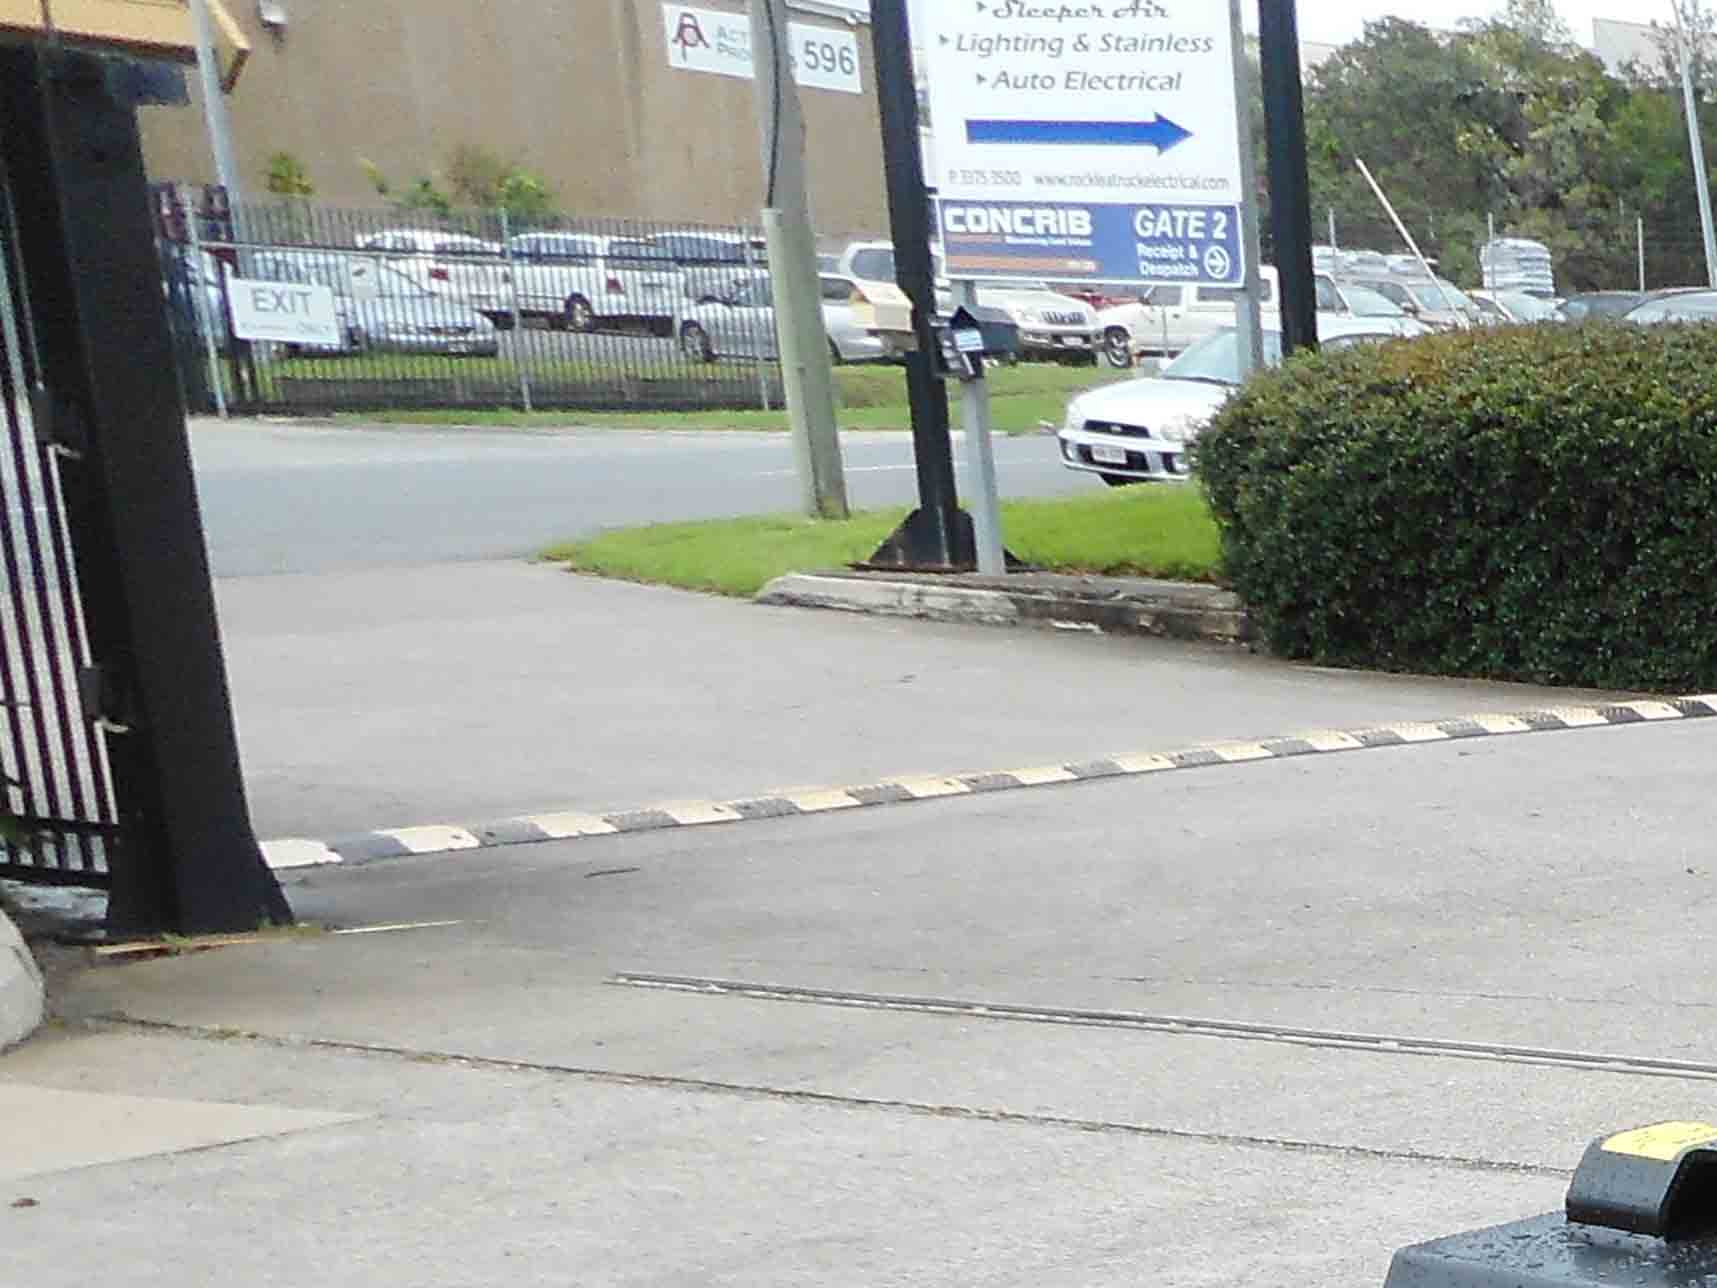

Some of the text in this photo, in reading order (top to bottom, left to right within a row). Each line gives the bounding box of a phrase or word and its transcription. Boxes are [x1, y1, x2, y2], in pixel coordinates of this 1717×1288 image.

[803, 39, 856, 75] 596
[956, 33, 1214, 58] Lighting & Stainless
[991, 70, 1182, 92] Auto Electrical
[944, 207, 1227, 239] CONCRIB GATE 2
[252, 287, 312, 316] EXIT
